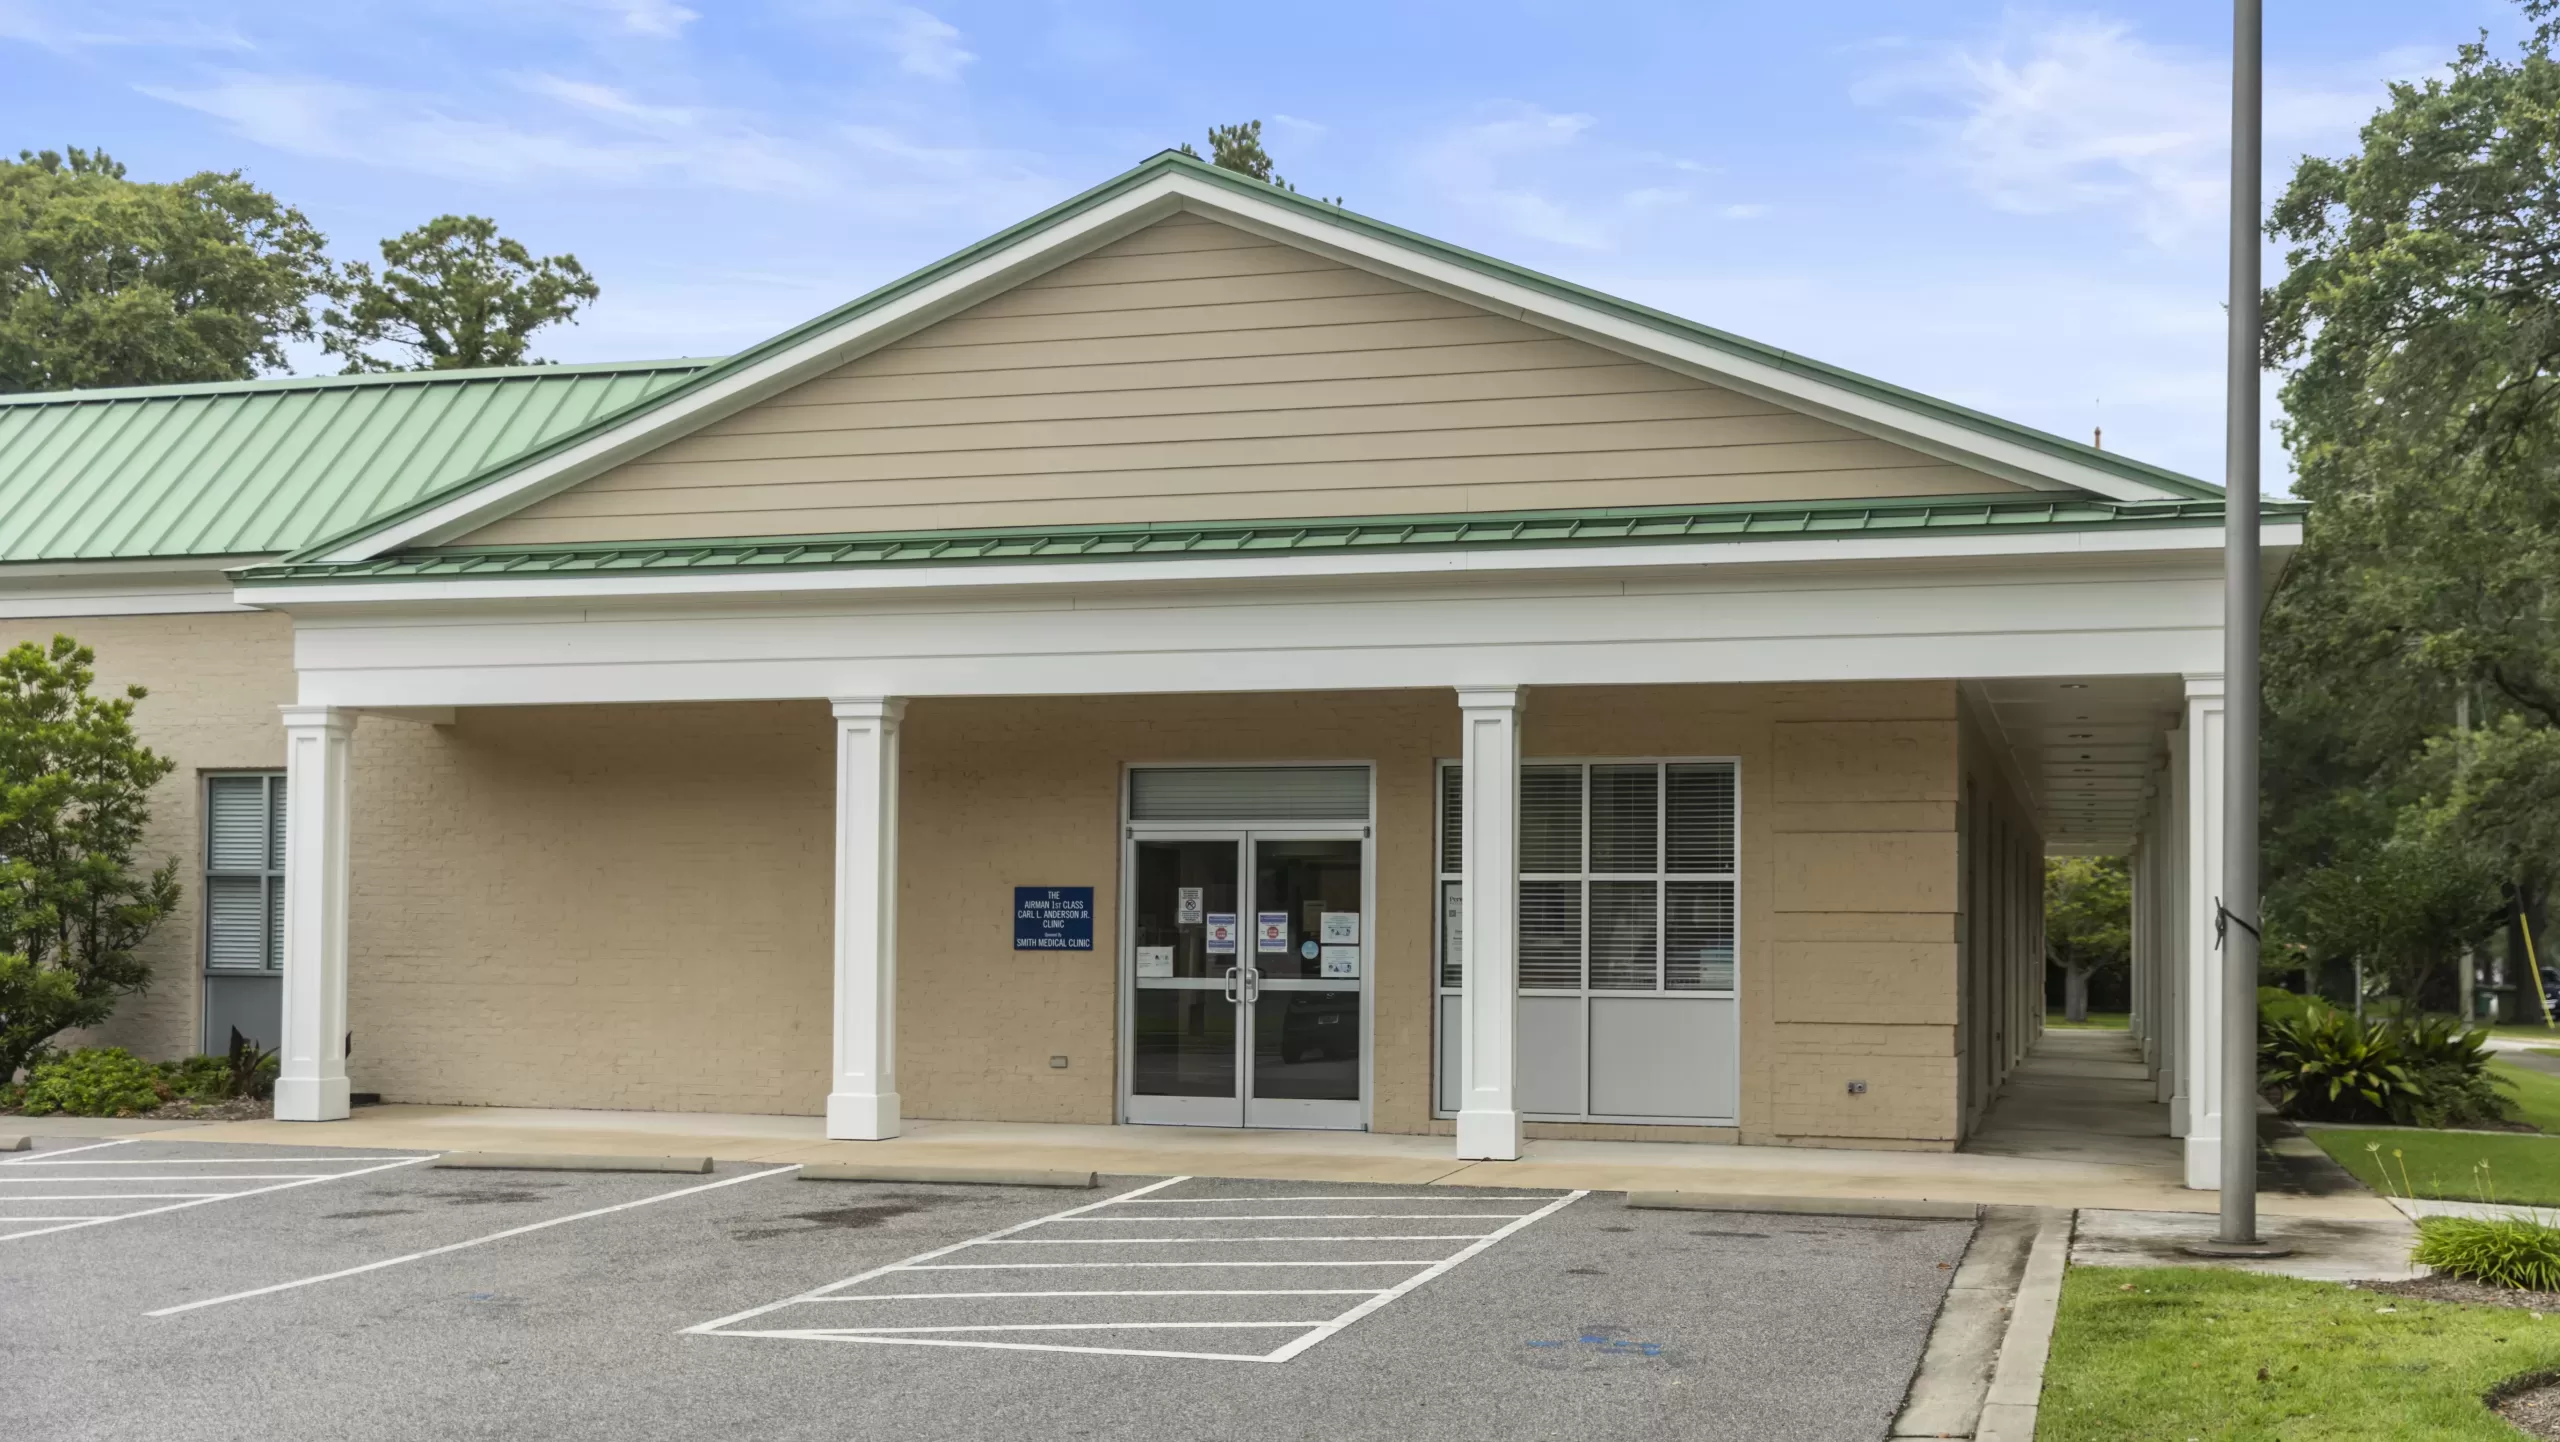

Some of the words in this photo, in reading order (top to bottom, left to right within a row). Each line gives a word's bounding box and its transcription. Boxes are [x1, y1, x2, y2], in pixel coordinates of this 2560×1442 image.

[1048, 891, 1060, 899] THE
[1024, 901, 1049, 909] AIRMAN
[1062, 901, 1084, 909] CLASS
[1017, 910, 1035, 918] CARL
[1043, 910, 1079, 919] ANDERSON
[1080, 910, 1090, 919] JR.
[1042, 920, 1064, 928] CLINIC
[1016, 938, 1037, 947] SMITH
[1038, 938, 1067, 947] MEDICAL
[1068, 938, 1090, 947] CLINIC
